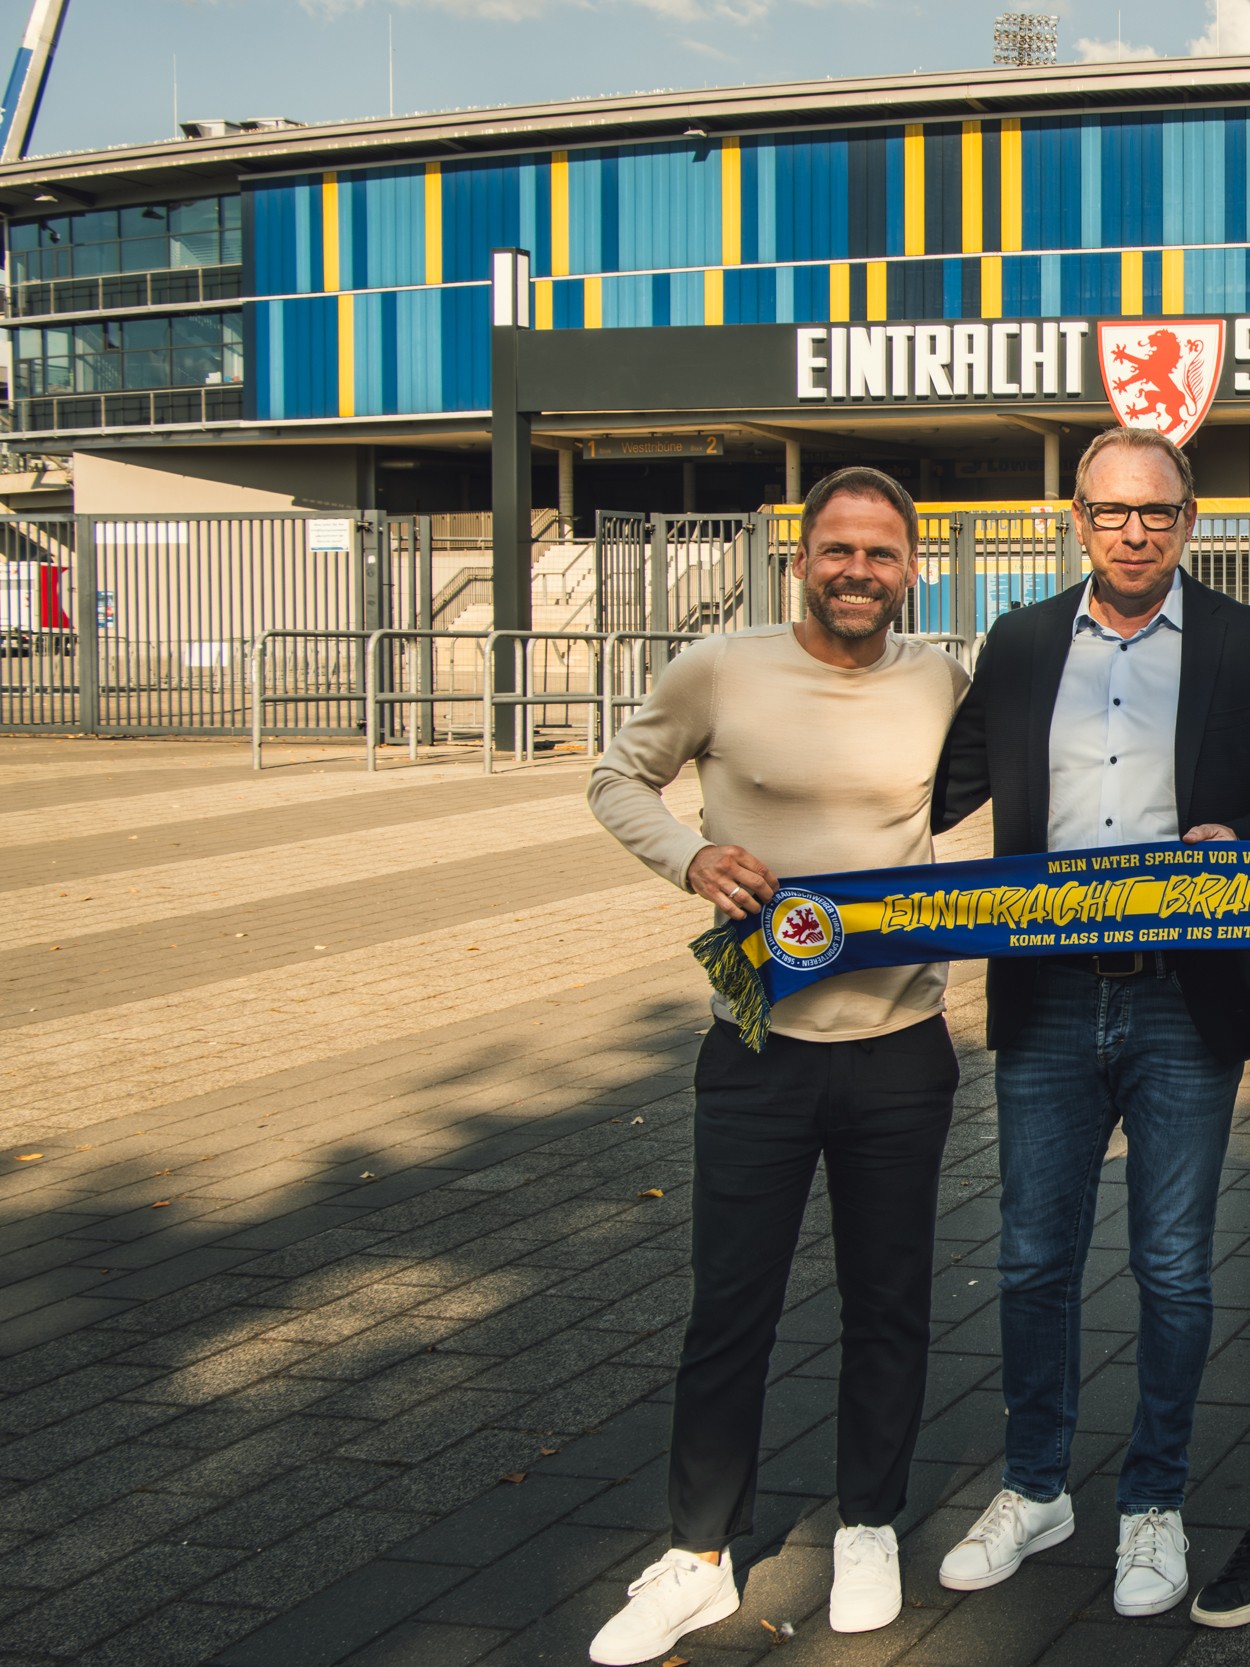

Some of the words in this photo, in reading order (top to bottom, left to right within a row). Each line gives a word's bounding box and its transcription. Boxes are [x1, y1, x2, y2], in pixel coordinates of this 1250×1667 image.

[797, 322, 1088, 400] EINTRACHT
[588, 440, 596, 458] 1
[706, 436, 717, 454] 2
[1047, 858, 1087, 874] MEIN
[1092, 854, 1140, 870] VATER
[1145, 851, 1203, 866] SPRACH
[1209, 850, 1238, 864] VOR
[880, 875, 1155, 934] EINTRACHT
[1009, 934, 1055, 947] KOMM
[1060, 932, 1098, 945] LASS
[1104, 930, 1134, 943] UNS
[1138, 928, 1183, 941] GEHN'
[1187, 926, 1213, 940] INS
